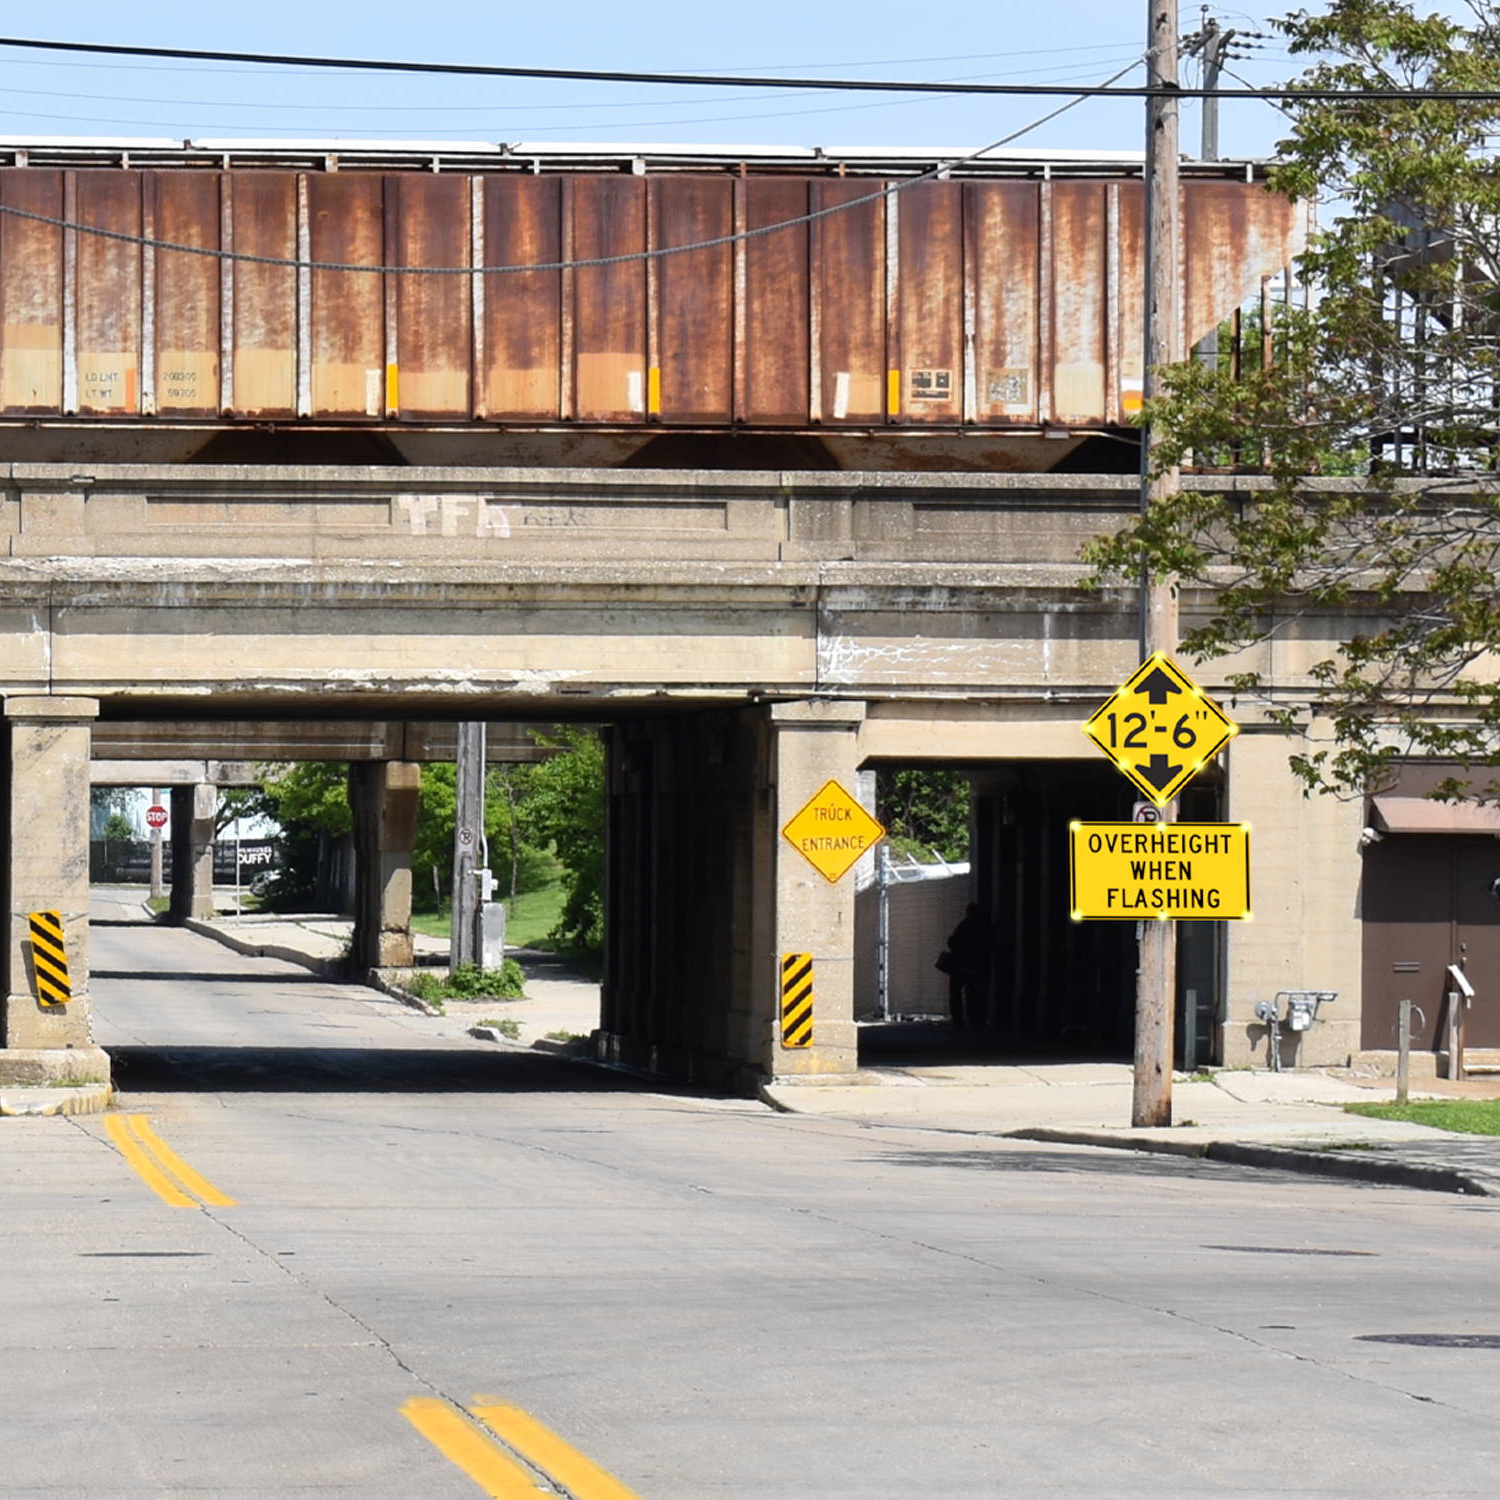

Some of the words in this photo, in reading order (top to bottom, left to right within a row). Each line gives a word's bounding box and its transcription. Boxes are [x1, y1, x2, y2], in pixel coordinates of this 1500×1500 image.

[145, 811, 168, 822] STOP
[812, 807, 853, 822] TRUCK
[802, 835, 866, 852] ENTRANCE
[1088, 833, 1232, 855] OVERHEIGHT
[1130, 861, 1193, 881] WHEN
[1107, 888, 1221, 909] FLASHING
